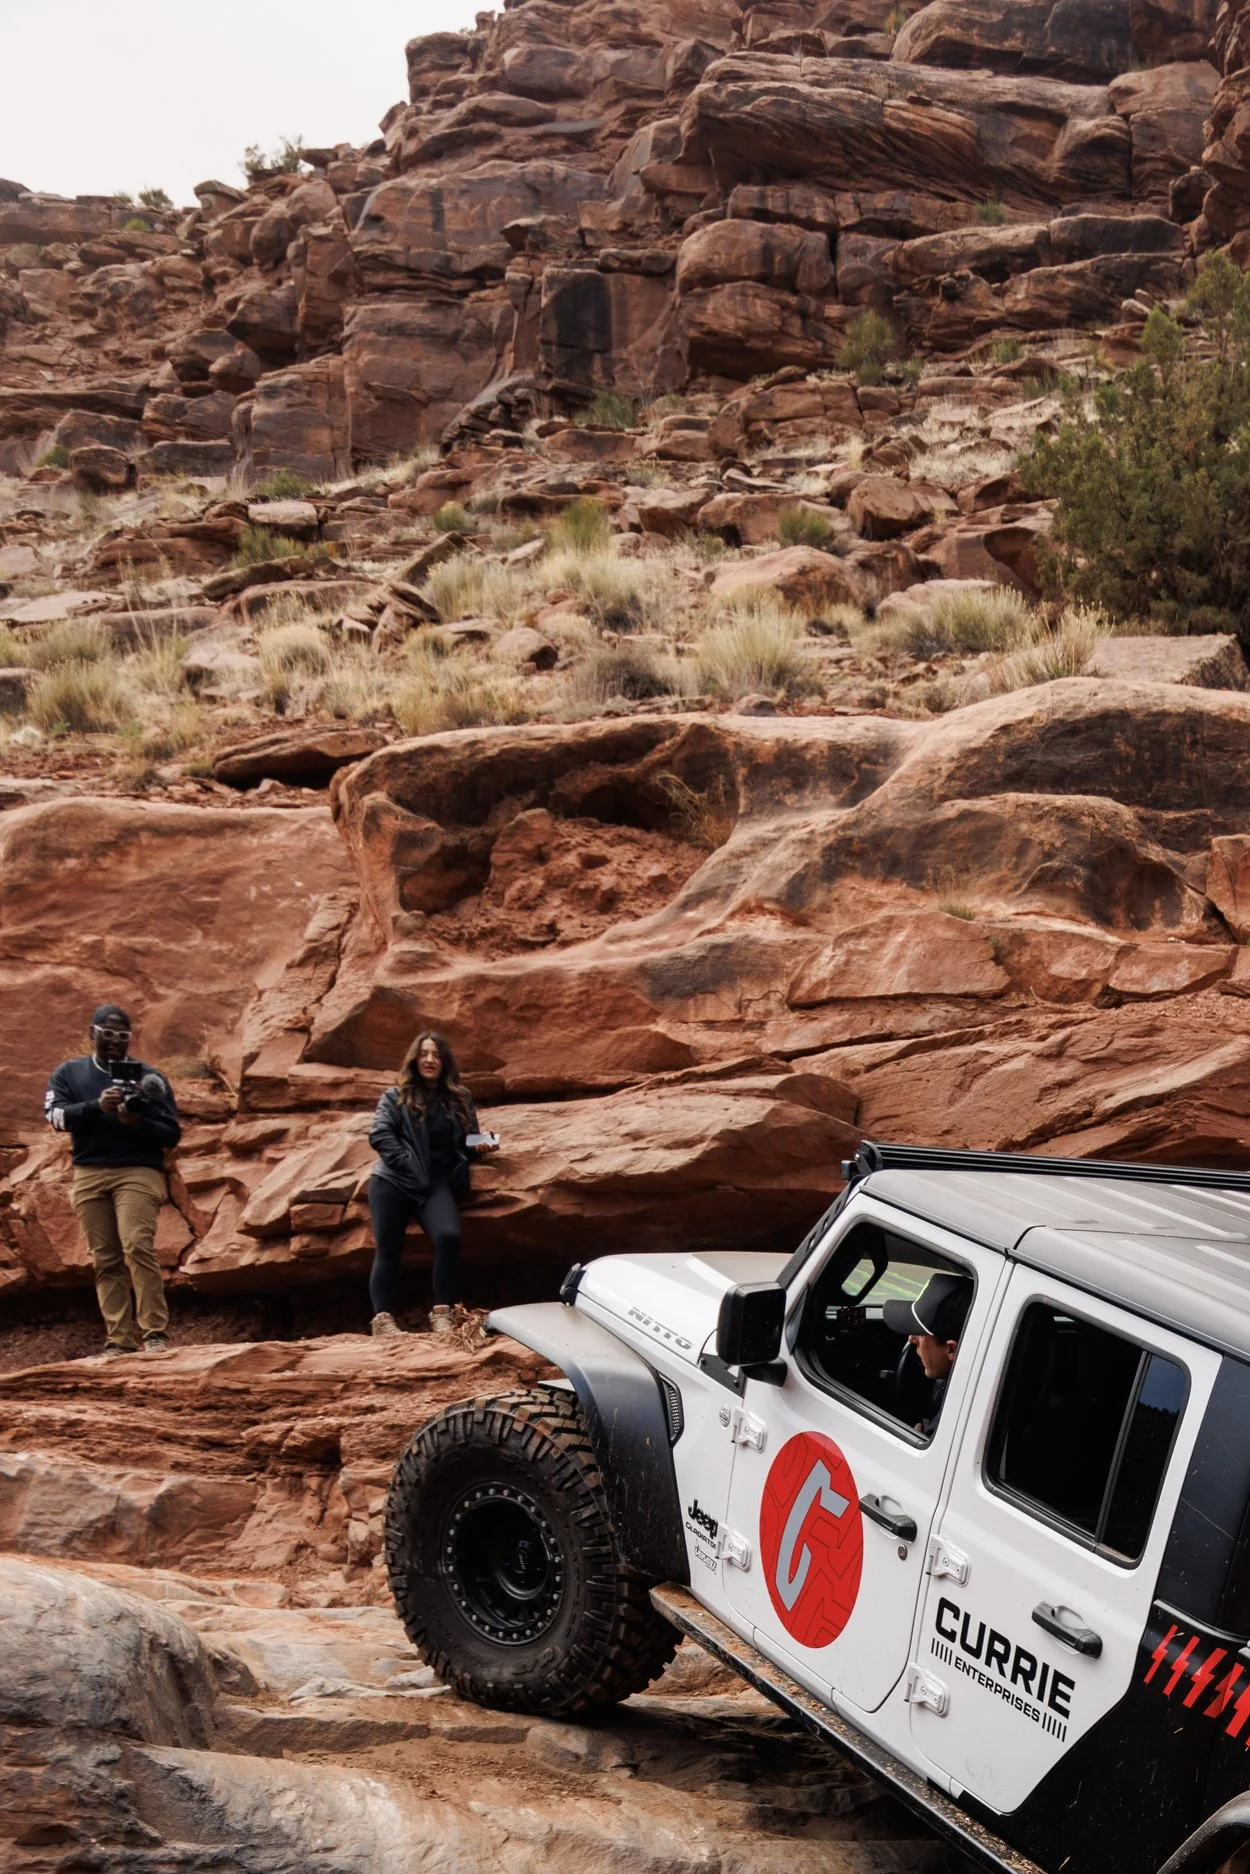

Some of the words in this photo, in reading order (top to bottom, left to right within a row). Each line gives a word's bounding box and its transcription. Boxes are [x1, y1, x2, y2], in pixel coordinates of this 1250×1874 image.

[628, 1306, 693, 1350] NITTO
[688, 1499, 719, 1540] Jeep
[935, 1596, 1076, 1720] CURRIE
[954, 1655, 1041, 1723] ENTERPRISES
